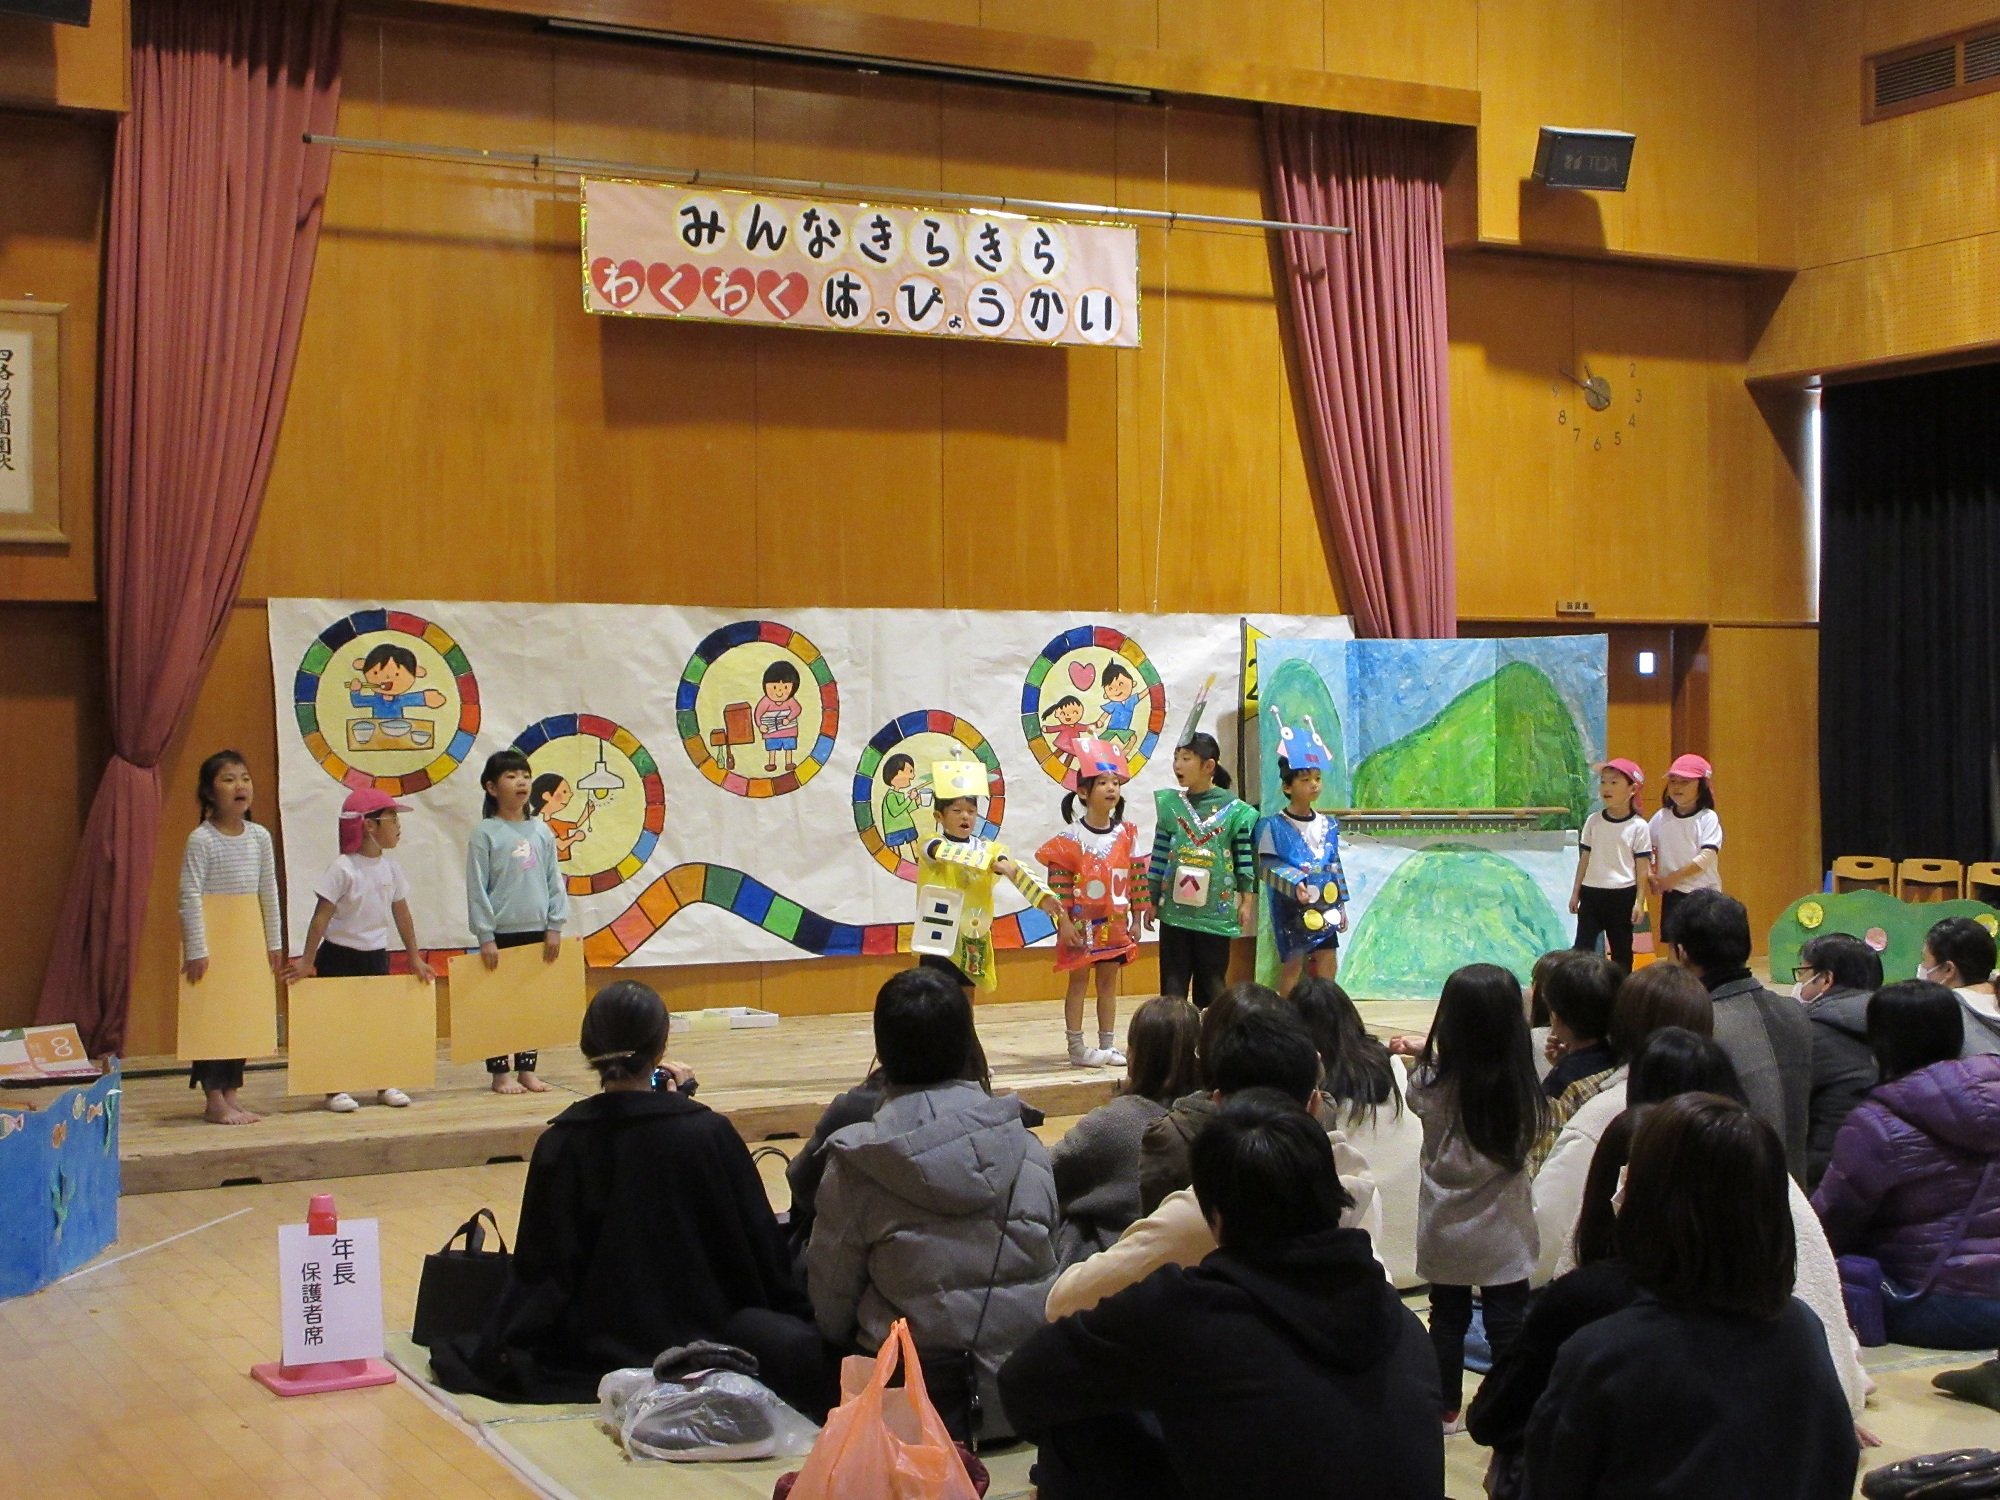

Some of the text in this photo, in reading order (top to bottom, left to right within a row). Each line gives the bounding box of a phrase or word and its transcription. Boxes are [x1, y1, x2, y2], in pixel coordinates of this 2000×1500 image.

[680, 203, 1055, 275] みんなきらきら
[1629, 362, 1637, 379] 2
[1634, 388, 1643, 404] 3
[1557, 409, 1567, 426] 8
[1628, 412, 1636, 429] 4
[1572, 427, 1581, 443] 7
[1613, 430, 1622, 446] 5
[1593, 436, 1602, 452] 6
[50, 1036, 74, 1058] 8
[331, 1237, 357, 1286] 年長
[301, 1261, 324, 1347] 保護者席
